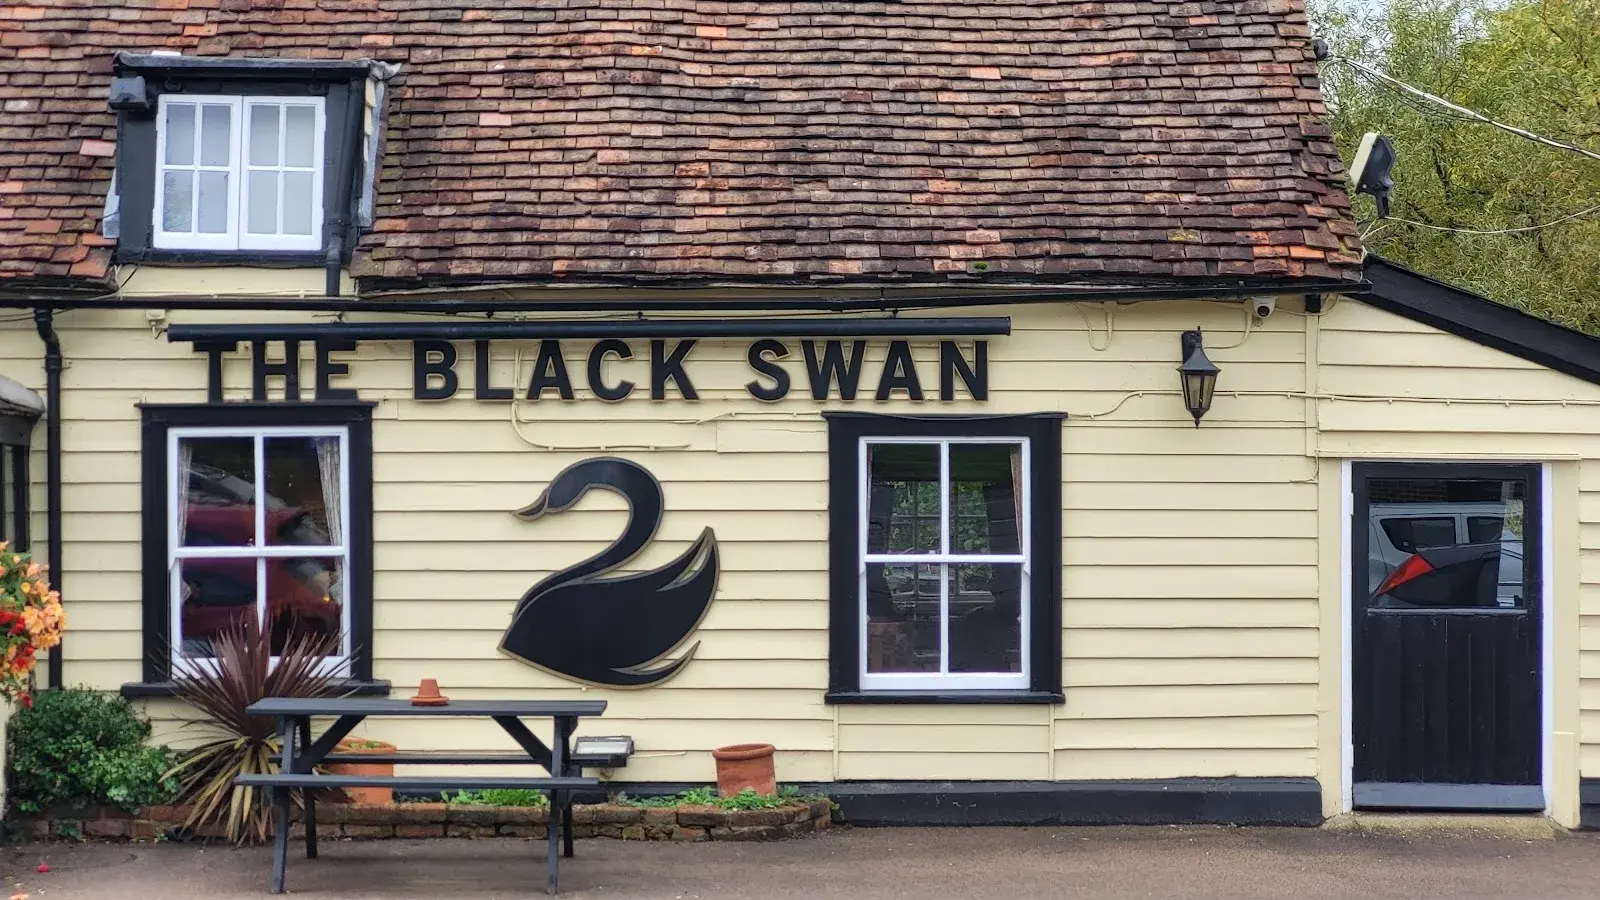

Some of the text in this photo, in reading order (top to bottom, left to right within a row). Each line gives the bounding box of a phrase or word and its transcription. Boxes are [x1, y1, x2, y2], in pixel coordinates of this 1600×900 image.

[193, 339, 989, 403] THE BLACK SWAN
